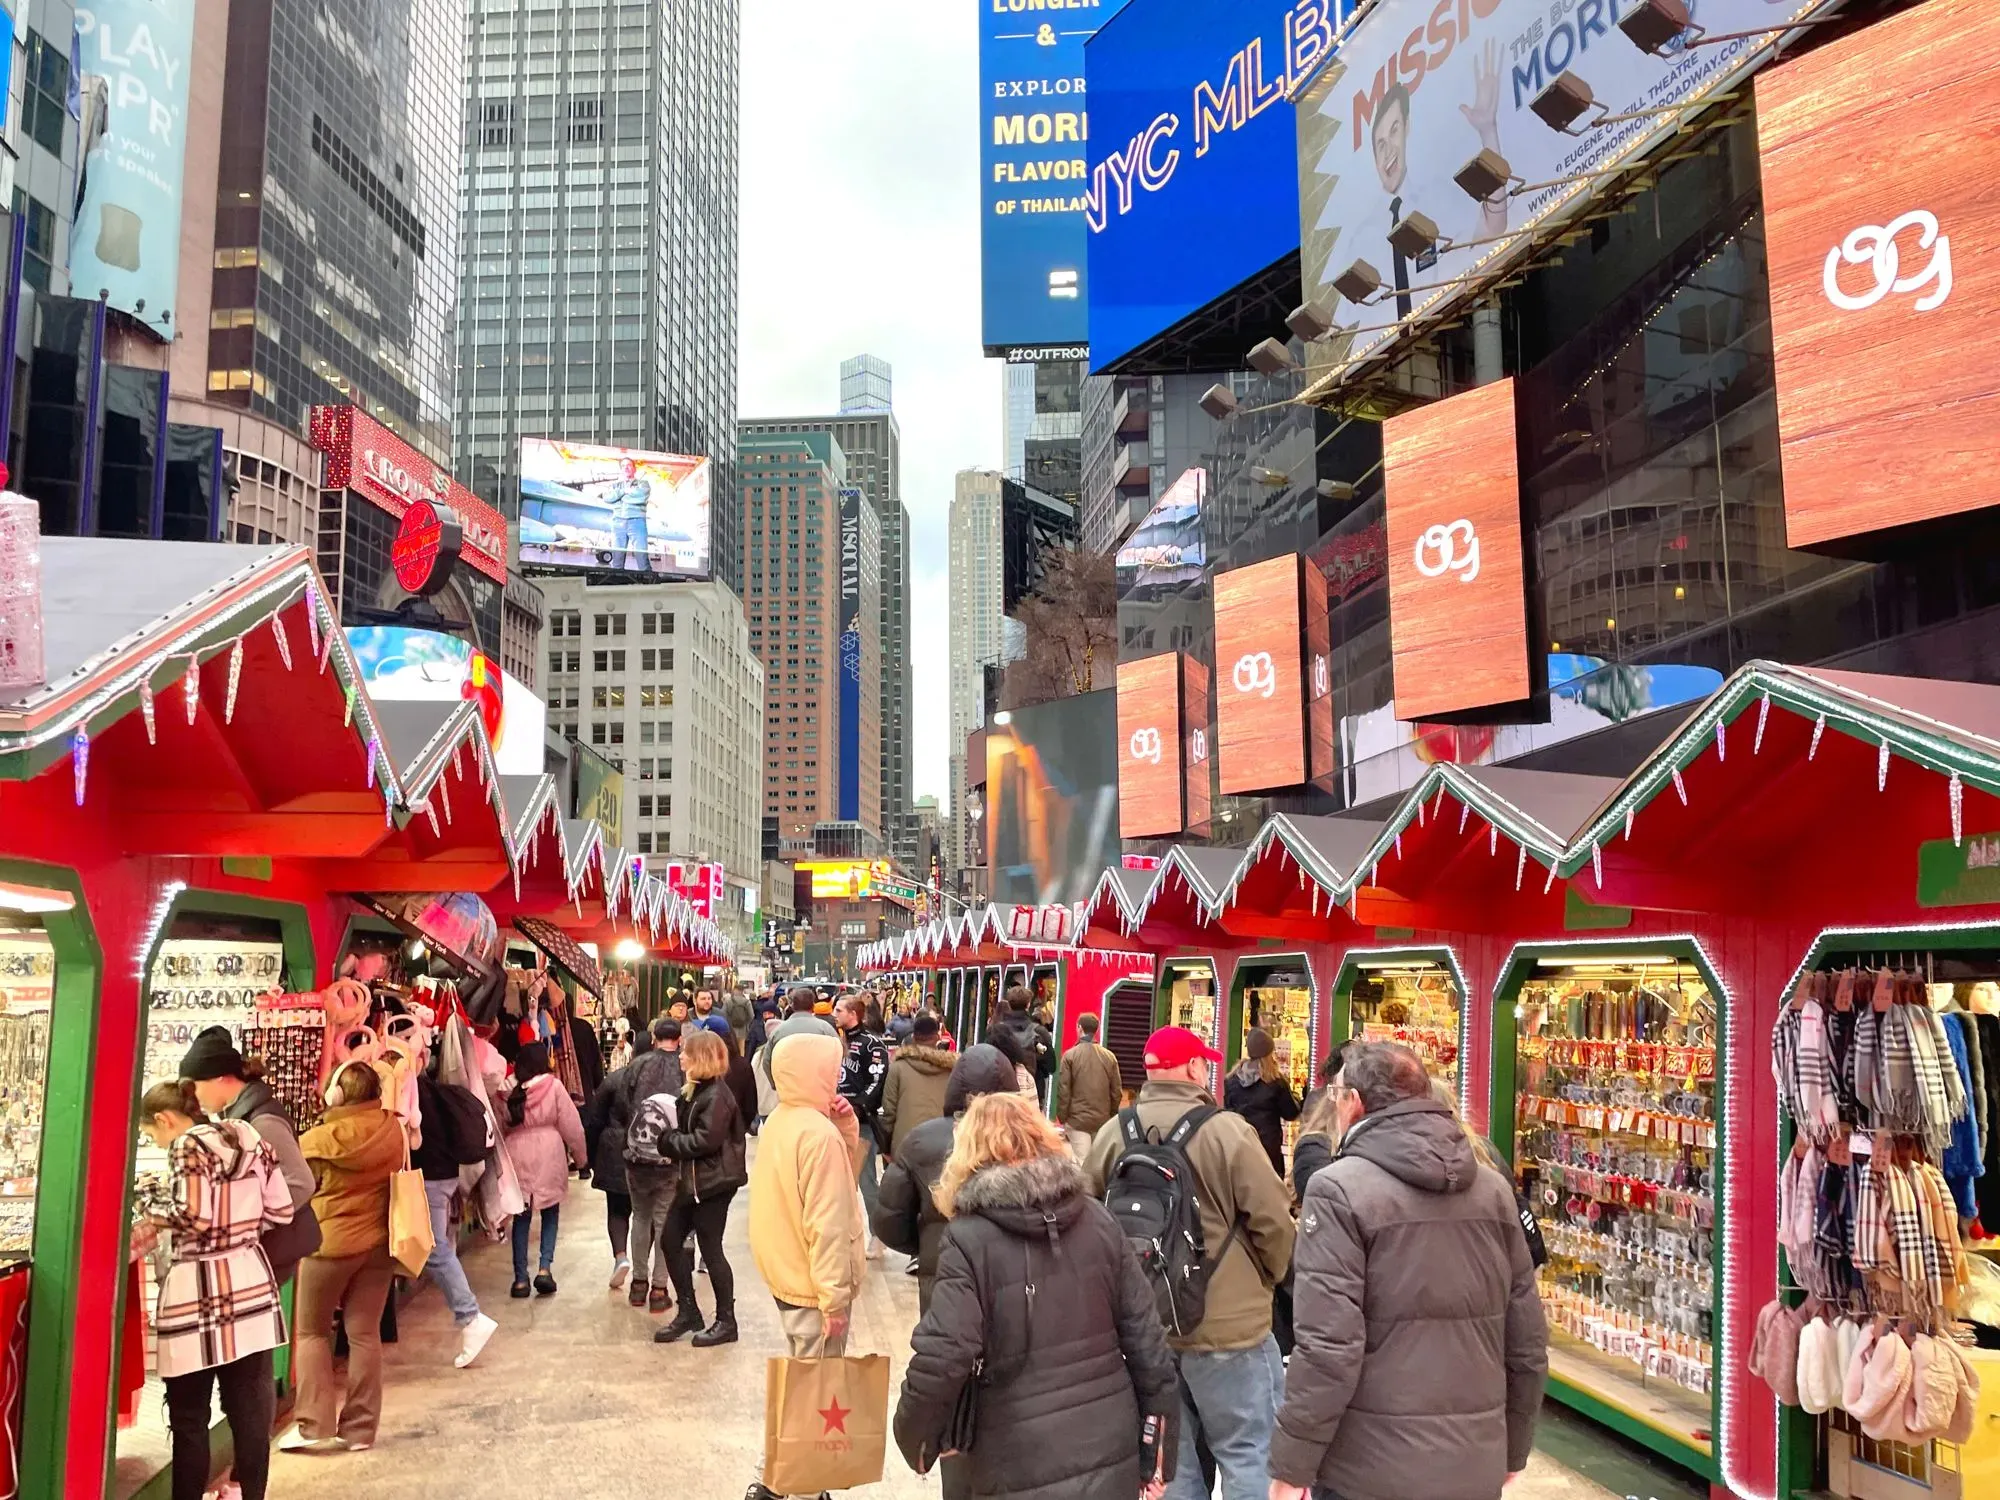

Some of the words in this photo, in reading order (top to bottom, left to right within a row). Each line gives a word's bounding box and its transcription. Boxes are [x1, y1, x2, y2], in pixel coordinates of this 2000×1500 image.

[1036, 23, 1057, 46] &
[1509, 17, 1544, 62] THE
[74, 8, 180, 92] PLAY
[1511, 0, 1628, 112] MOR
[994, 77, 1087, 98] EXPLOR
[106, 71, 180, 148] PR"
[1564, 132, 1604, 173] EUGENE
[1647, 51, 1700, 101] THEATRE
[1527, 36, 1750, 213] WWW.OOKOFMORMONROADWAY.COM
[994, 159, 1088, 183] FLAVOR
[995, 200, 1017, 215] OF
[1008, 347, 1090, 362] #OUTFRON
[886, 886, 896, 894] 48
[421, 933, 434, 947] New
[433, 941, 448, 955] York
